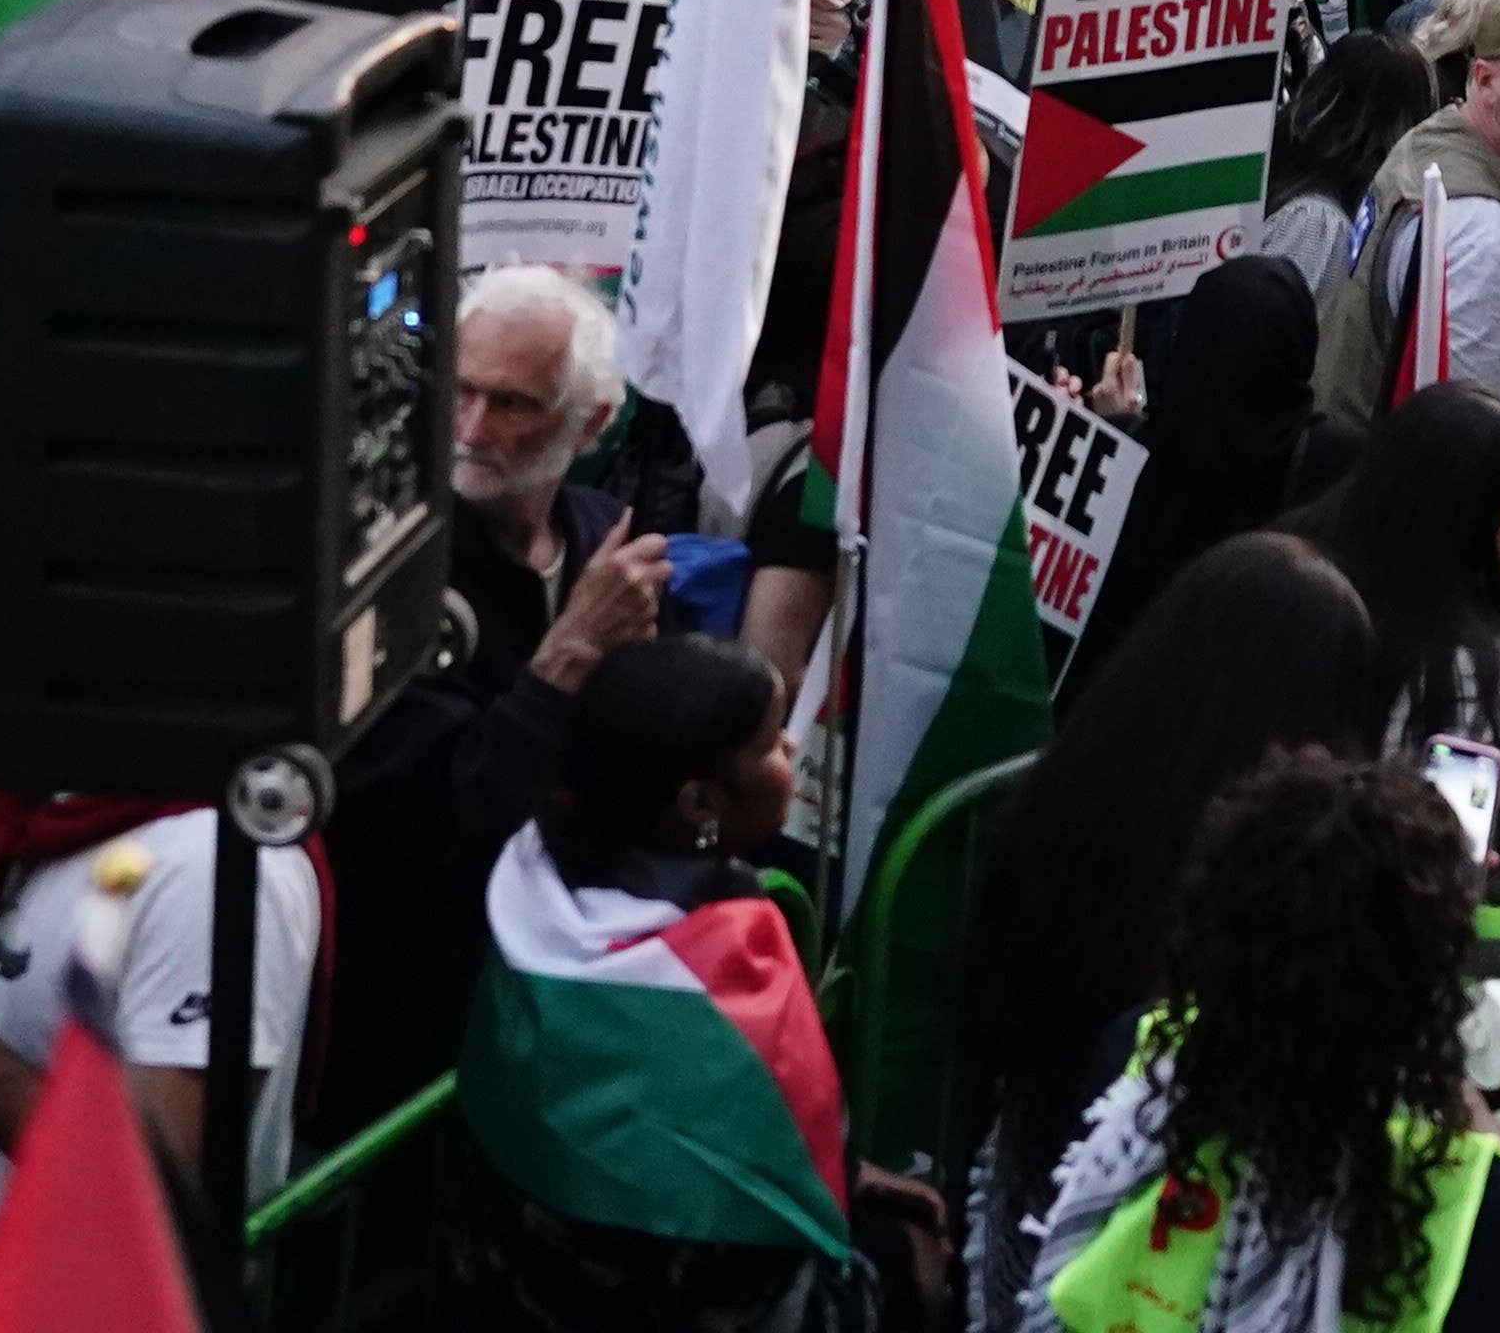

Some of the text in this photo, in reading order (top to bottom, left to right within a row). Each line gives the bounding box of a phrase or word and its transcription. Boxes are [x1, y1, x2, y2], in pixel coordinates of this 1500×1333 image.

[1013, 255, 1089, 279] Palestine
[1091, 246, 1140, 269] Forum
[1161, 233, 1211, 256] Britain
